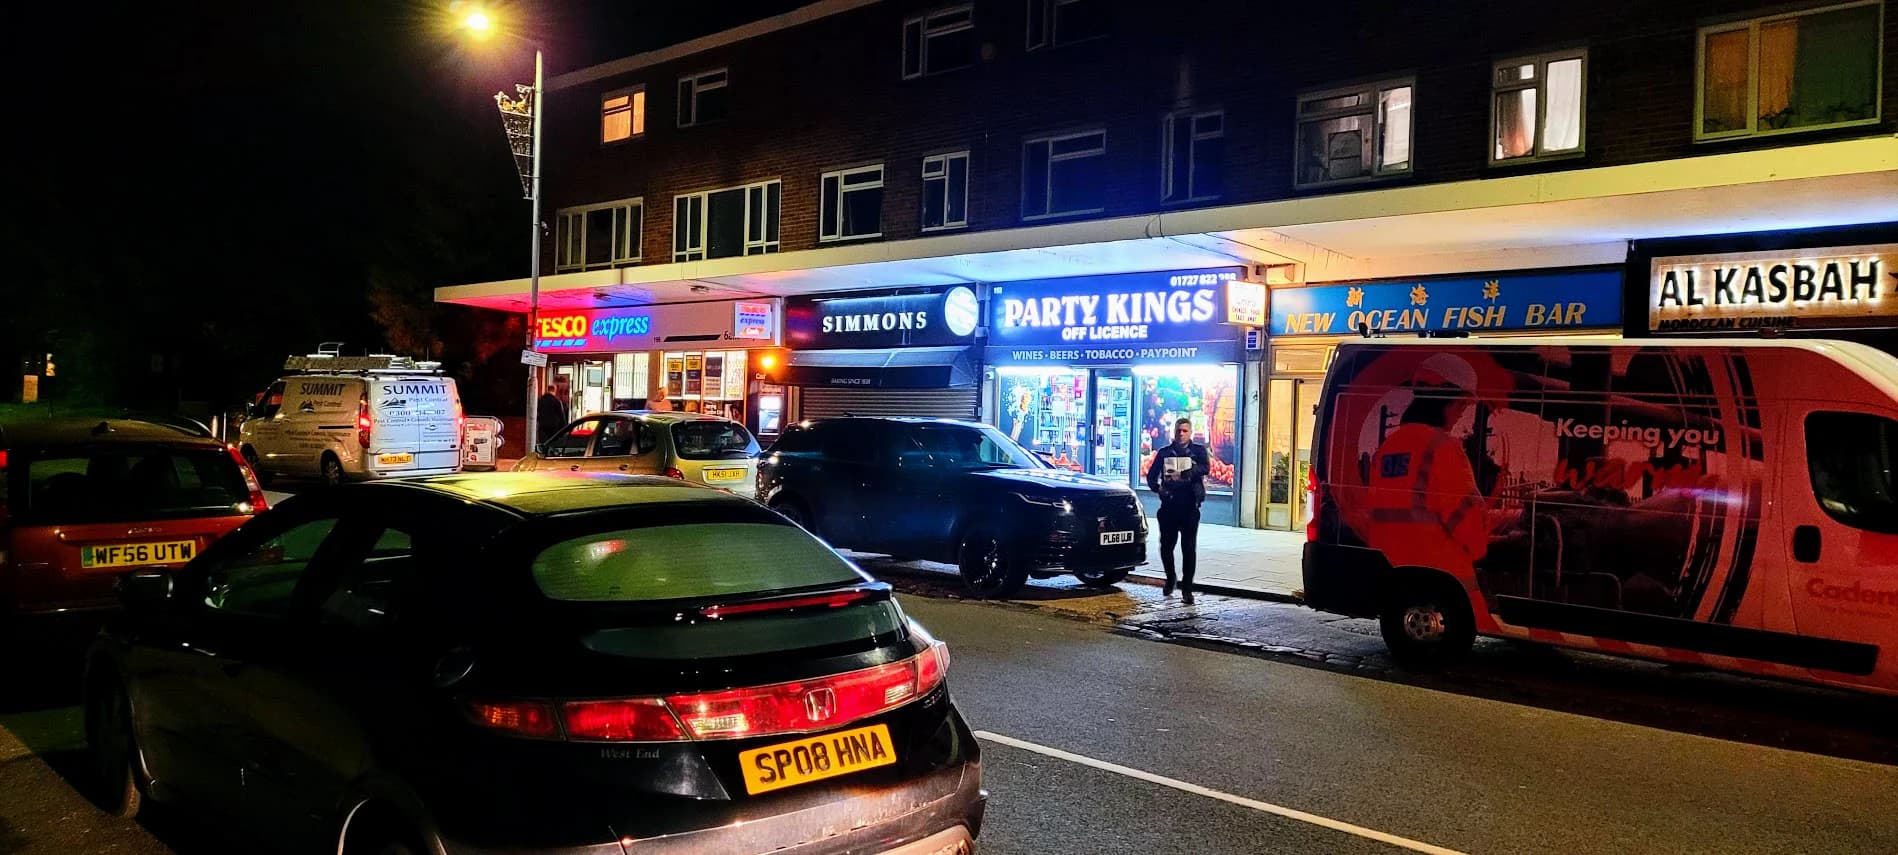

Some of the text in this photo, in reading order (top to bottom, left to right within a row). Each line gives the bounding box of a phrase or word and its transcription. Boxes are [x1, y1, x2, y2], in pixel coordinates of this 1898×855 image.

[1169, 274, 1199, 287] 01727
[1659, 259, 1880, 306] AL KASBAH
[1410, 283, 1429, 306] 海
[1003, 289, 1216, 327] PARTY KINGS
[1285, 302, 1587, 334] NEW OCEAN FISH BAR
[592, 315, 649, 342] express
[822, 311, 898, 333] SIMMONS
[1062, 325, 1148, 341] OFF LICENCE
[1013, 347, 1198, 361] WINES BEERS TOBACCO PAYPOINT
[301, 383, 345, 396] SUMMIT
[383, 385, 447, 395] SUMMIT
[1555, 417, 1720, 450] Keeping you
[95, 543, 192, 564] WF56 UTW
[600, 747, 660, 759] West End
[754, 732, 888, 785] SP08 HNA
